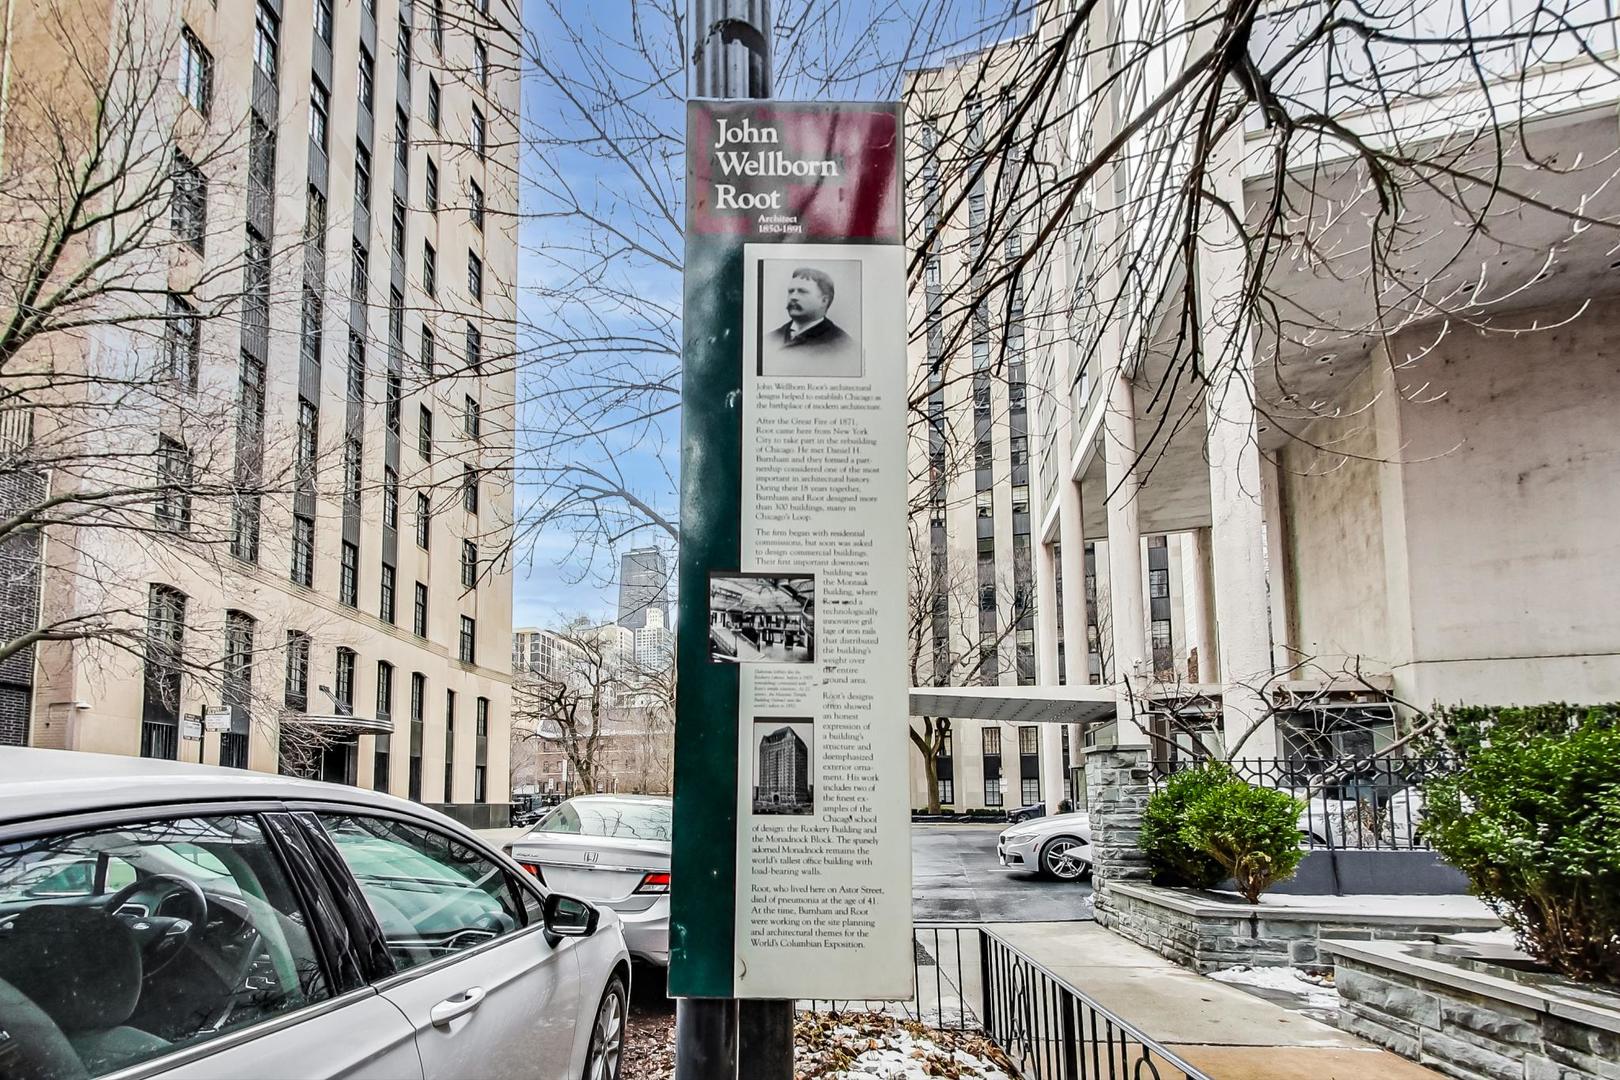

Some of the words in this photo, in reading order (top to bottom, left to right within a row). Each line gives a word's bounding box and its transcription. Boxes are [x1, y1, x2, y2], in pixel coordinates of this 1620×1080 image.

[715, 119, 778, 148] John
[715, 152, 838, 176] Wellborn
[715, 185, 781, 209] Root
[758, 215, 797, 224] Architect
[759, 224, 802, 234] 1850-1891
[823, 692, 845, 700] Root's
[848, 692, 873, 702] designs
[823, 702, 842, 710] often
[844, 702, 871, 710] showed
[834, 712, 858, 720] honest
[823, 723, 861, 732] expression
[863, 722, 870, 730] of
[829, 732, 864, 742] building's
[858, 743, 871, 751] and
[847, 773, 859, 781] His
[861, 773, 879, 781] work
[823, 783, 851, 791] includes
[868, 784, 875, 792] of
[823, 793, 834, 801] the
[837, 794, 855, 802] finest
[823, 804, 847, 814] amples
[849, 804, 857, 812] of
[860, 804, 872, 812] the
[854, 815, 877, 823] school
[752, 824, 760, 832] of
[787, 825, 798, 833] the
[801, 825, 829, 835] Rookery
[832, 825, 861, 835] Building
[864, 826, 877, 834] and
[752, 835, 764, 843] the
[766, 835, 807, 843] Monadnock
[837, 836, 851, 844] The
[752, 846, 780, 854] adorned
[782, 846, 823, 854] Monadnock
[857, 846, 869, 854] the
[752, 856, 778, 864] world's
[780, 856, 800, 864] tallest
[803, 857, 822, 865] office
[824, 857, 853, 867] building
[856, 857, 872, 865] with
[752, 867, 799, 877] load-bearing
[751, 884, 771, 893] Root,
[773, 885, 788, 893] who
[791, 885, 808, 893] lived
[810, 885, 825, 893] here
[839, 886, 859, 894] Astor
[861, 886, 884, 895] Street,
[751, 895, 767, 903] died
[769, 895, 776, 903] of
[778, 897, 819, 905] pneumonia
[831, 896, 842, 904] the
[858, 896, 865, 904] of
[751, 906, 761, 914] At
[764, 906, 775, 914] the
[777, 907, 795, 915] time,
[799, 907, 832, 915] Burnham
[835, 907, 848, 915] and
[851, 907, 868, 915] Root
[770, 917, 799, 927] working
[814, 918, 825, 926] the
[842, 918, 875, 928] planning
[751, 928, 764, 936] and
[767, 928, 812, 936] architectural
[815, 929, 842, 937] themes
[845, 929, 854, 937] for
[857, 929, 868, 937] the
[751, 938, 778, 946] World's
[780, 939, 822, 947] Columbian
